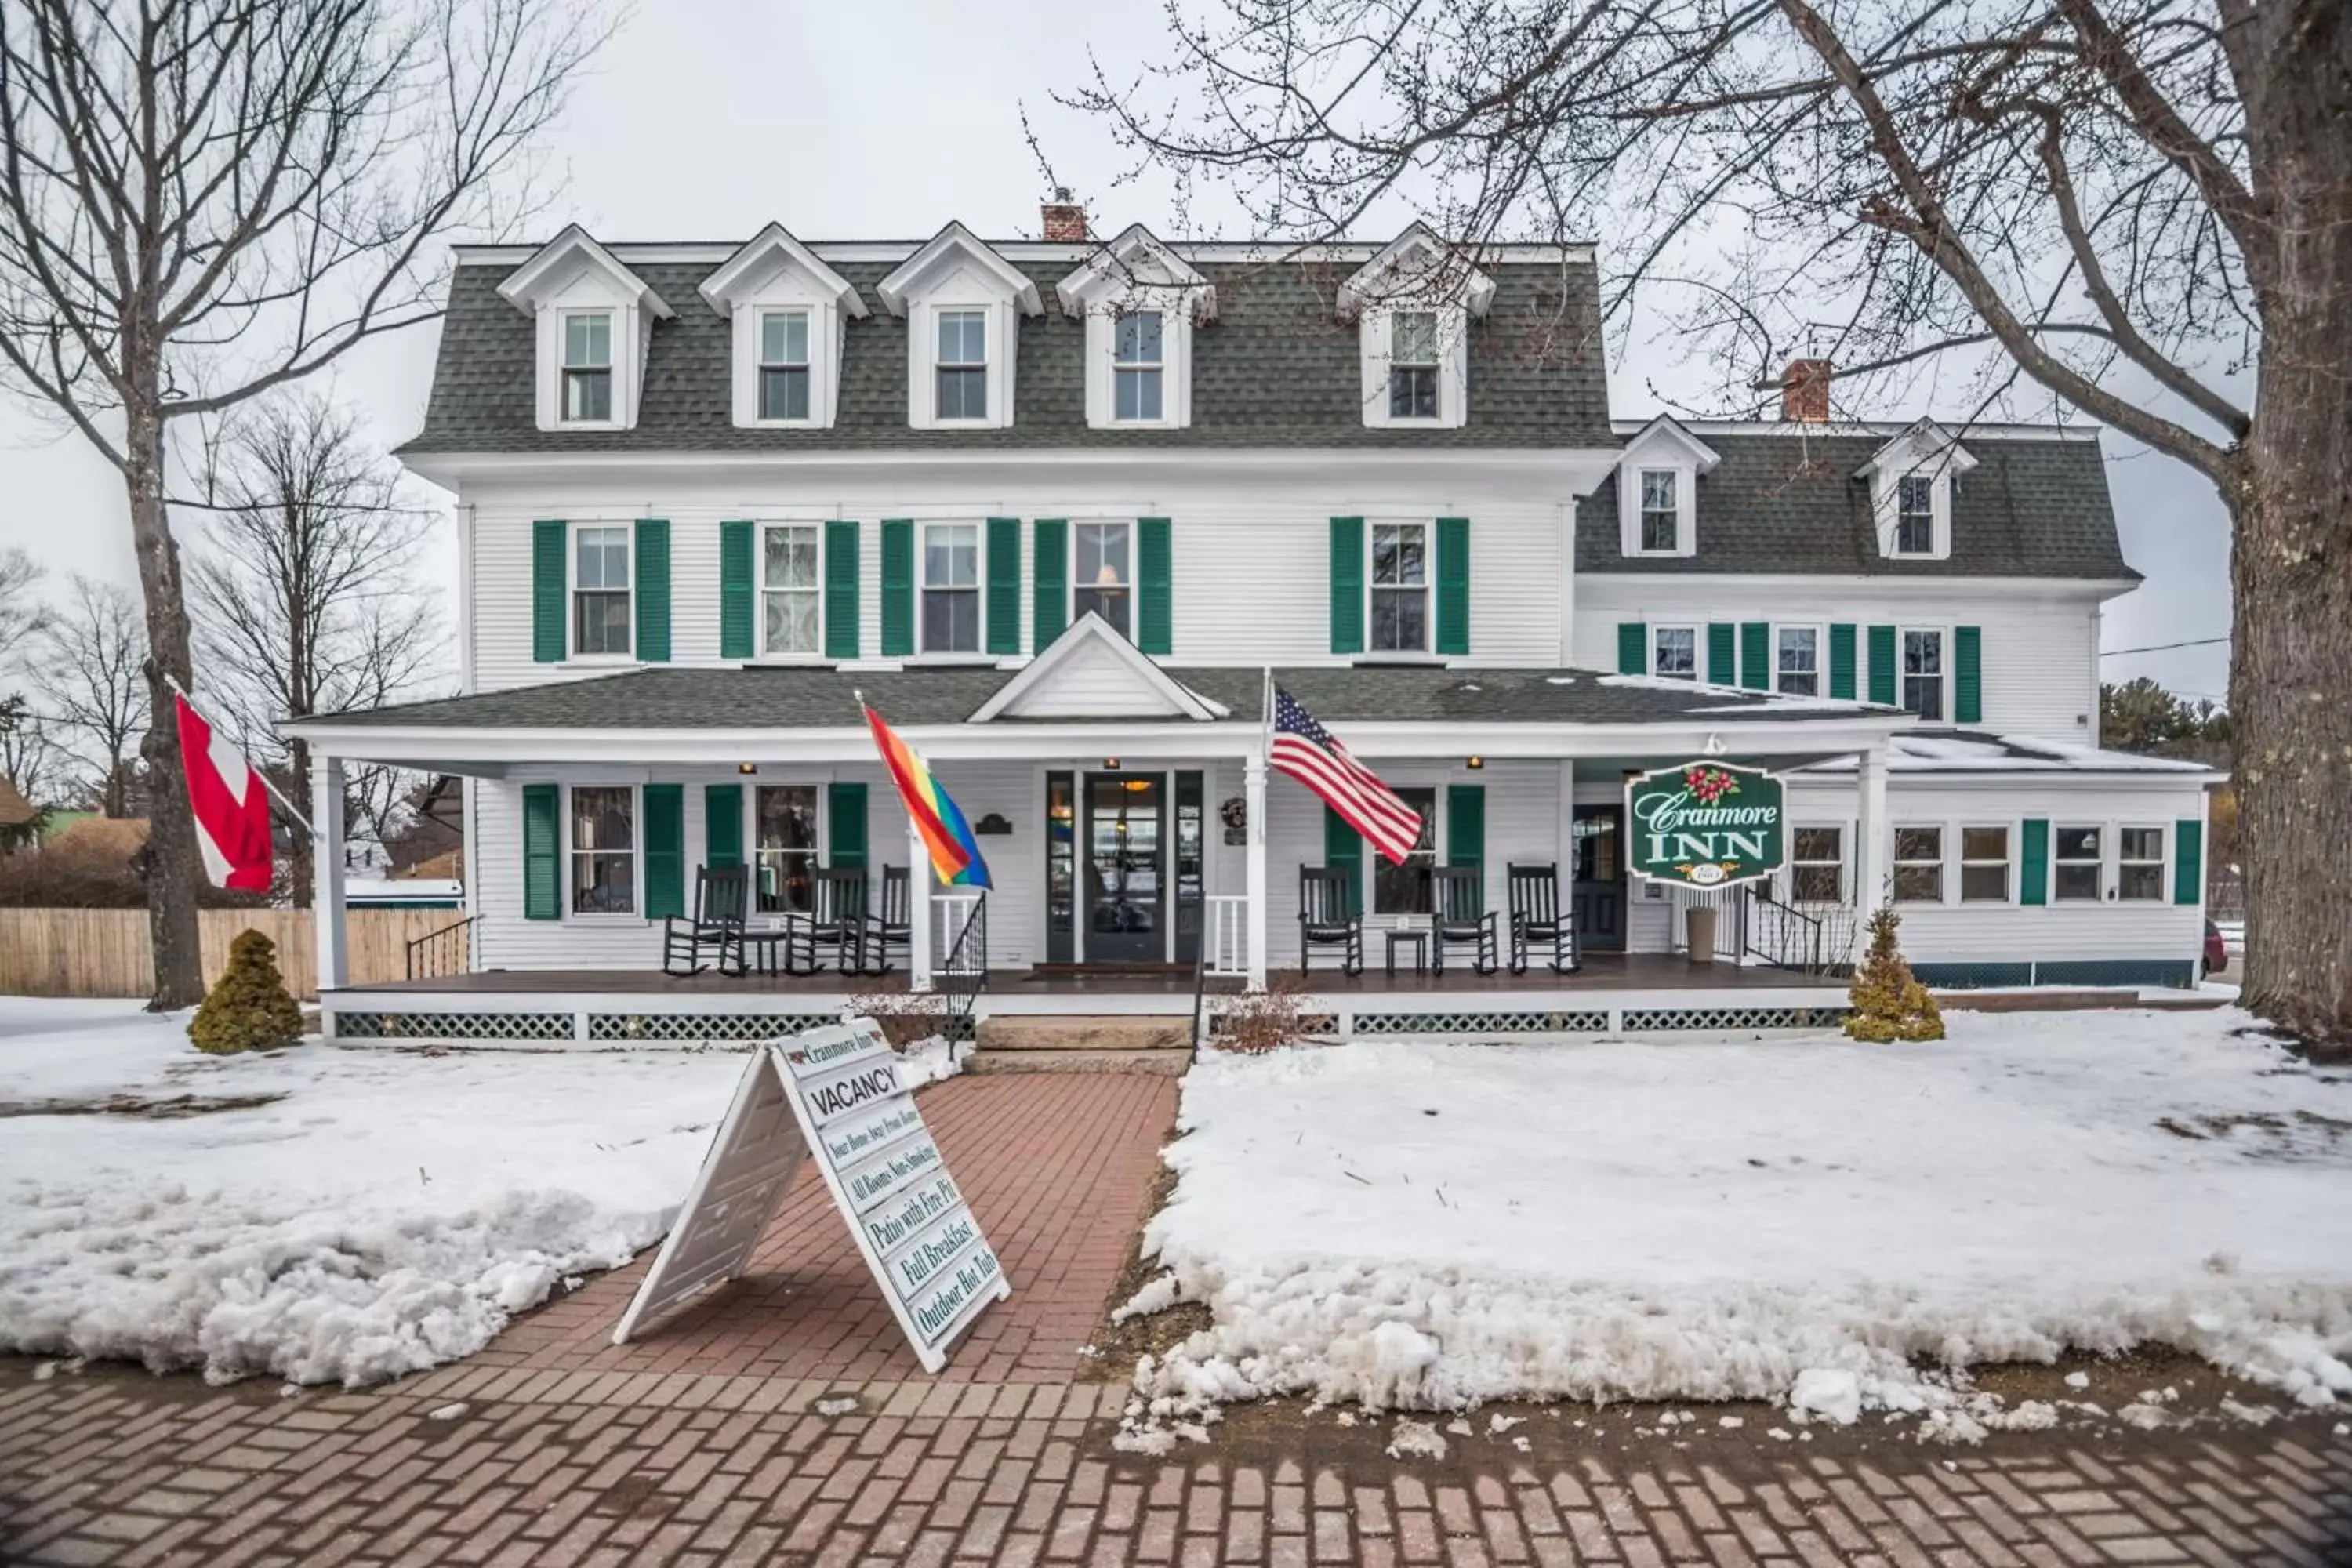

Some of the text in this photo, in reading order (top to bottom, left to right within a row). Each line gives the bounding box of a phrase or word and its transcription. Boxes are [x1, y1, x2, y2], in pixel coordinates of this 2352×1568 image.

[1635, 791, 1777, 833] Cranmore
[1645, 831, 1768, 863] INN
[804, 1032, 874, 1063] Cranmore Inn
[811, 1066, 897, 1116] VACANCY
[851, 1178, 868, 1201] All
[862, 1170, 893, 1194] Rooms
[870, 1178, 957, 1250] Patio with Fire Pit
[900, 1220, 973, 1286] Full Breakfast
[918, 1249, 996, 1334] Outdoor Hot Tub
